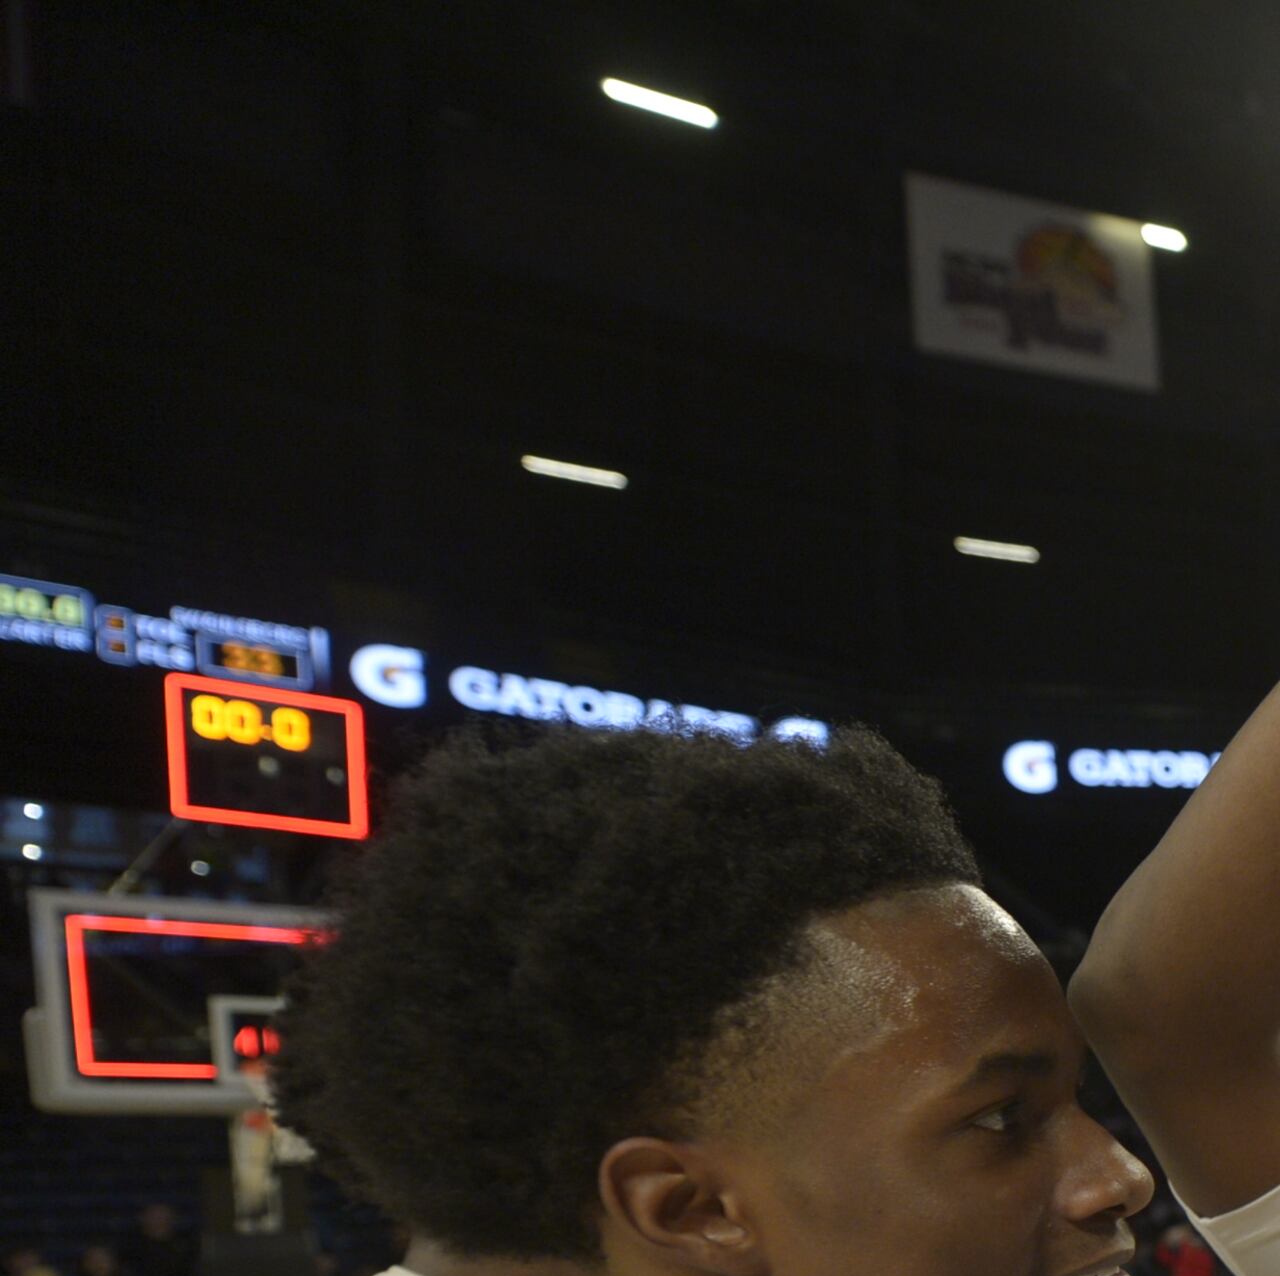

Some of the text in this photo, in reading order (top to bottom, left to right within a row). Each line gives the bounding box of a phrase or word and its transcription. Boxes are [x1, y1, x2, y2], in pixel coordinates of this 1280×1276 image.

[191, 694, 311, 752] 00.0
[348, 642, 428, 709] G
[448, 665, 758, 750] GATORADE
[1002, 740, 1222, 795] G GATOR
